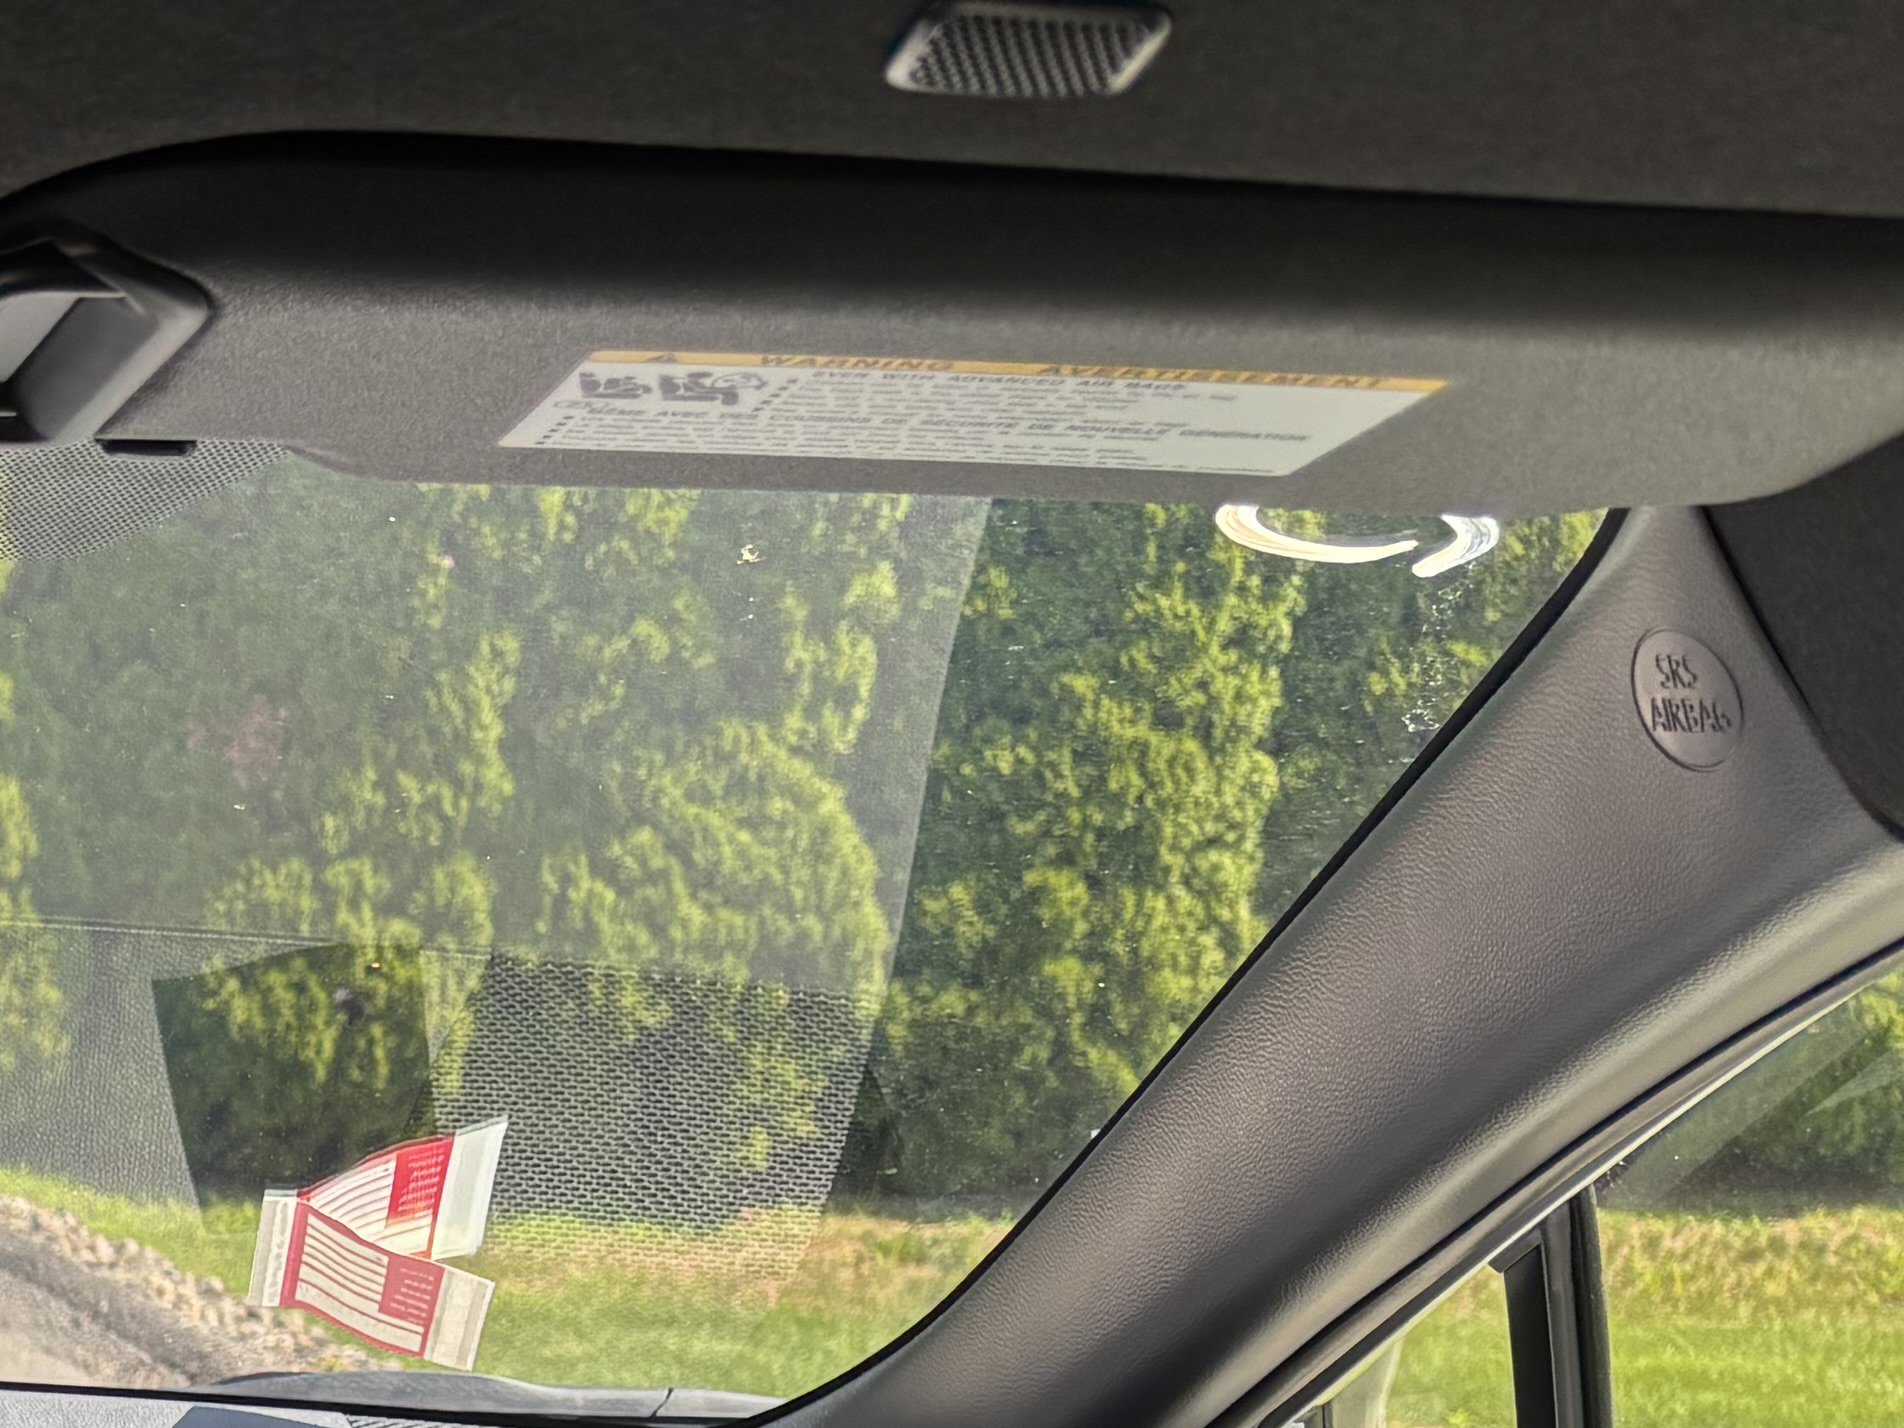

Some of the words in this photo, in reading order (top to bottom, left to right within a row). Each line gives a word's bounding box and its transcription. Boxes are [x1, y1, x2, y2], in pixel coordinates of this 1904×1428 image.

[761, 354, 954, 372] WARNING
[1038, 363, 1382, 389] AVERTISSEMENT
[1655, 653, 1698, 689] SRS
[1650, 697, 1733, 733] AIRBAG
